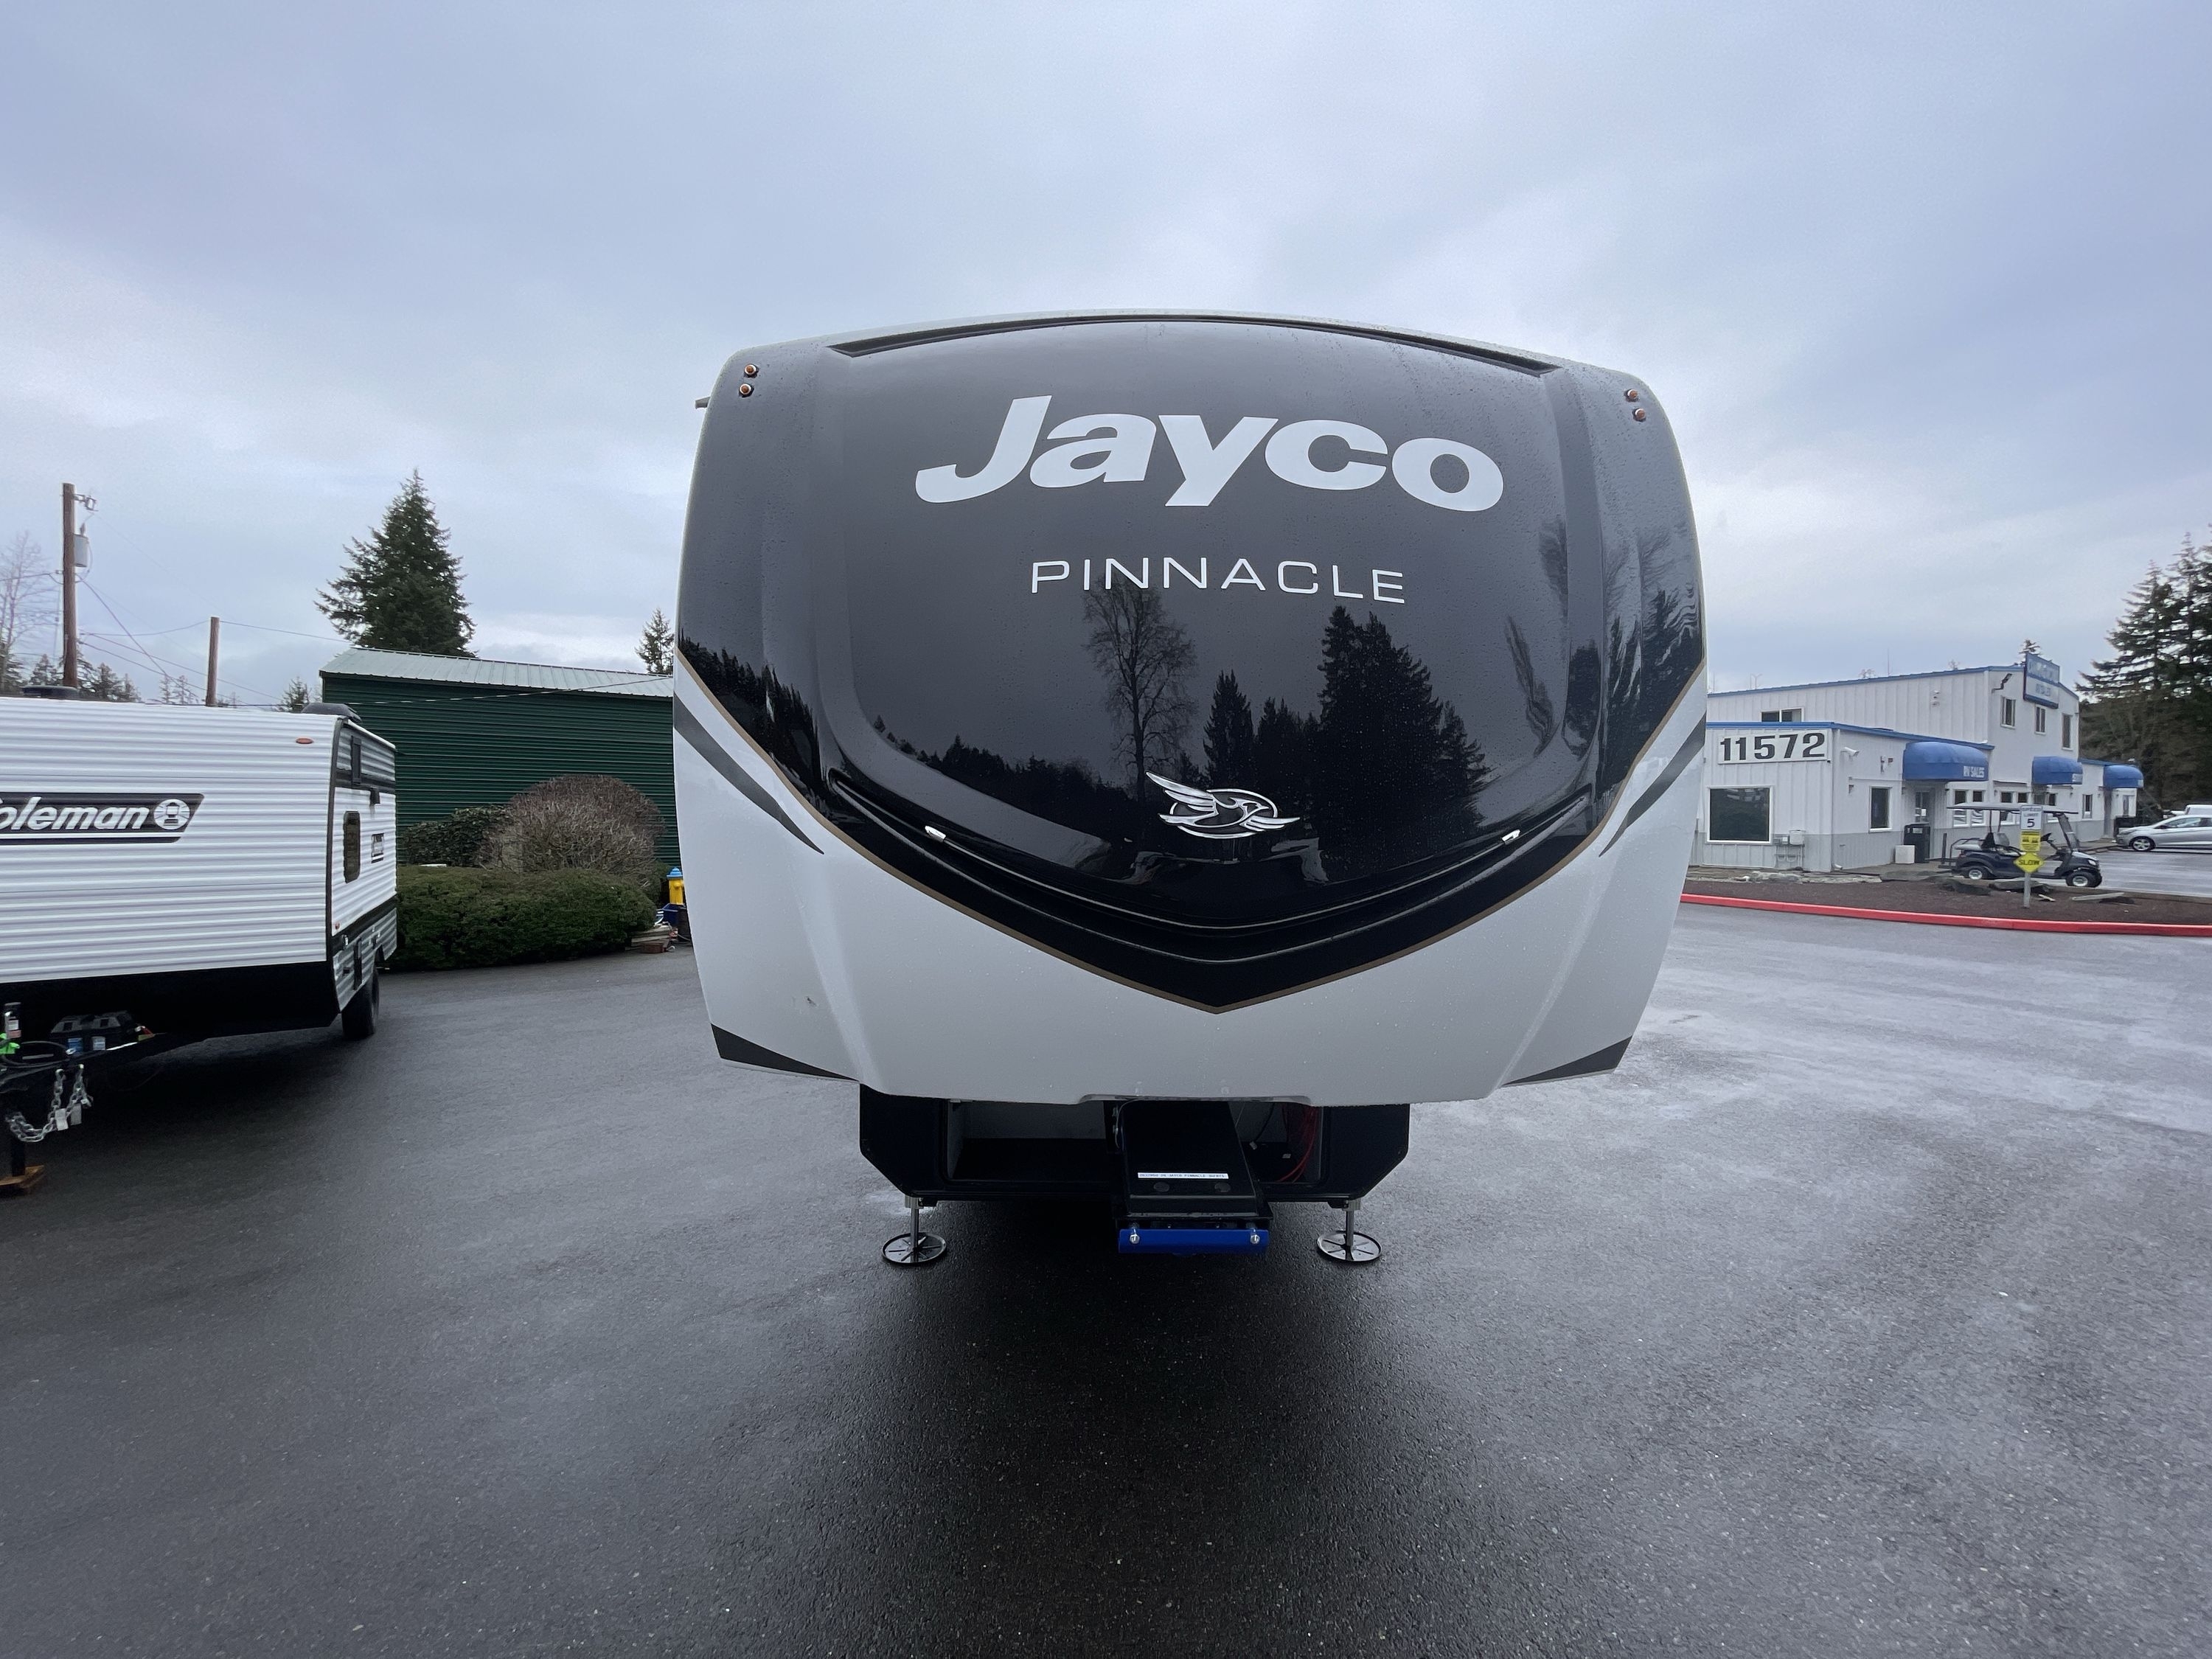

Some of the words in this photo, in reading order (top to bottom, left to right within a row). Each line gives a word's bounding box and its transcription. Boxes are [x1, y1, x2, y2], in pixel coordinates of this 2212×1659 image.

[915, 395, 1504, 512] Jayco
[1032, 557, 1405, 604] PINNACLE
[1720, 732, 1825, 761] 11572
[1970, 766, 1985, 778] SALES
[0, 797, 150, 830] oleman
[2027, 818, 2035, 828] 5
